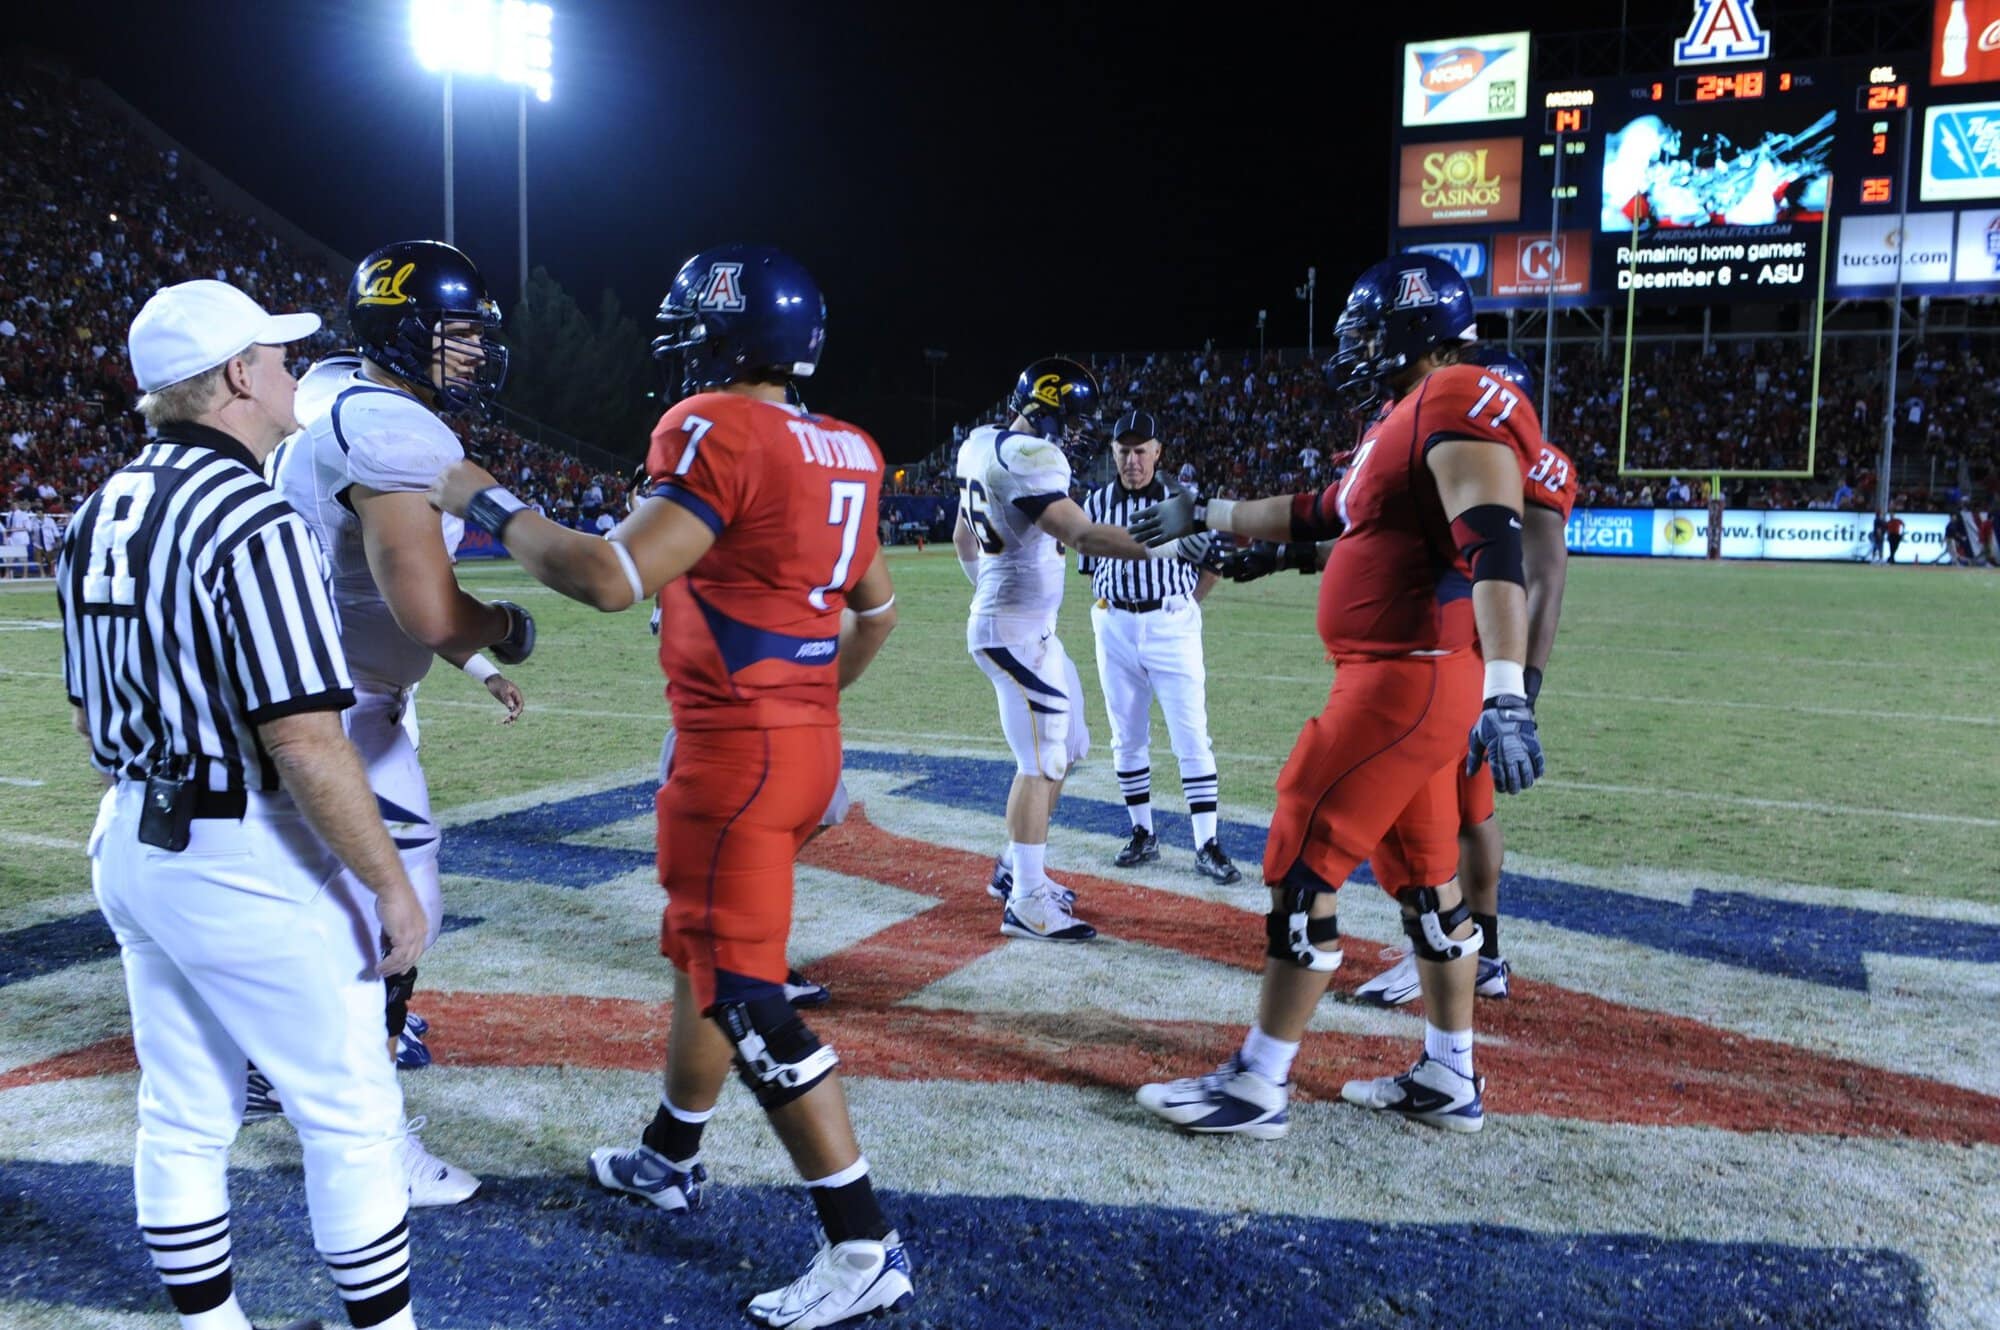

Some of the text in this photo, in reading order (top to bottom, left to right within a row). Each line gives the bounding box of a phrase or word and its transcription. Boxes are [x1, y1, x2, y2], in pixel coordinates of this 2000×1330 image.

[1674, 0, 1770, 66] A
[1696, 71, 1763, 101] 2:48
[1867, 84, 1907, 110] 24
[1556, 109, 1581, 132] 14
[1421, 149, 1500, 191] SOL
[1421, 187, 1500, 208] CASINOS
[1862, 178, 1890, 203] 25
[1617, 242, 1807, 264] Remaining home games:
[1842, 251, 1948, 267] tucson.com
[356, 258, 415, 306] Cal
[703, 262, 747, 312] A
[1395, 268, 1439, 310] A
[1618, 267, 1715, 290] December
[1718, 266, 1732, 286] 6
[1757, 263, 1804, 284] ASU
[1467, 375, 1519, 428] 77
[674, 414, 715, 475] 7
[1583, 512, 1633, 527] Tucson
[1697, 522, 1943, 545] www.tucsoncitizcom
[83, 471, 156, 605] R
[808, 480, 867, 612] 7
[1564, 521, 1634, 547] tizen
